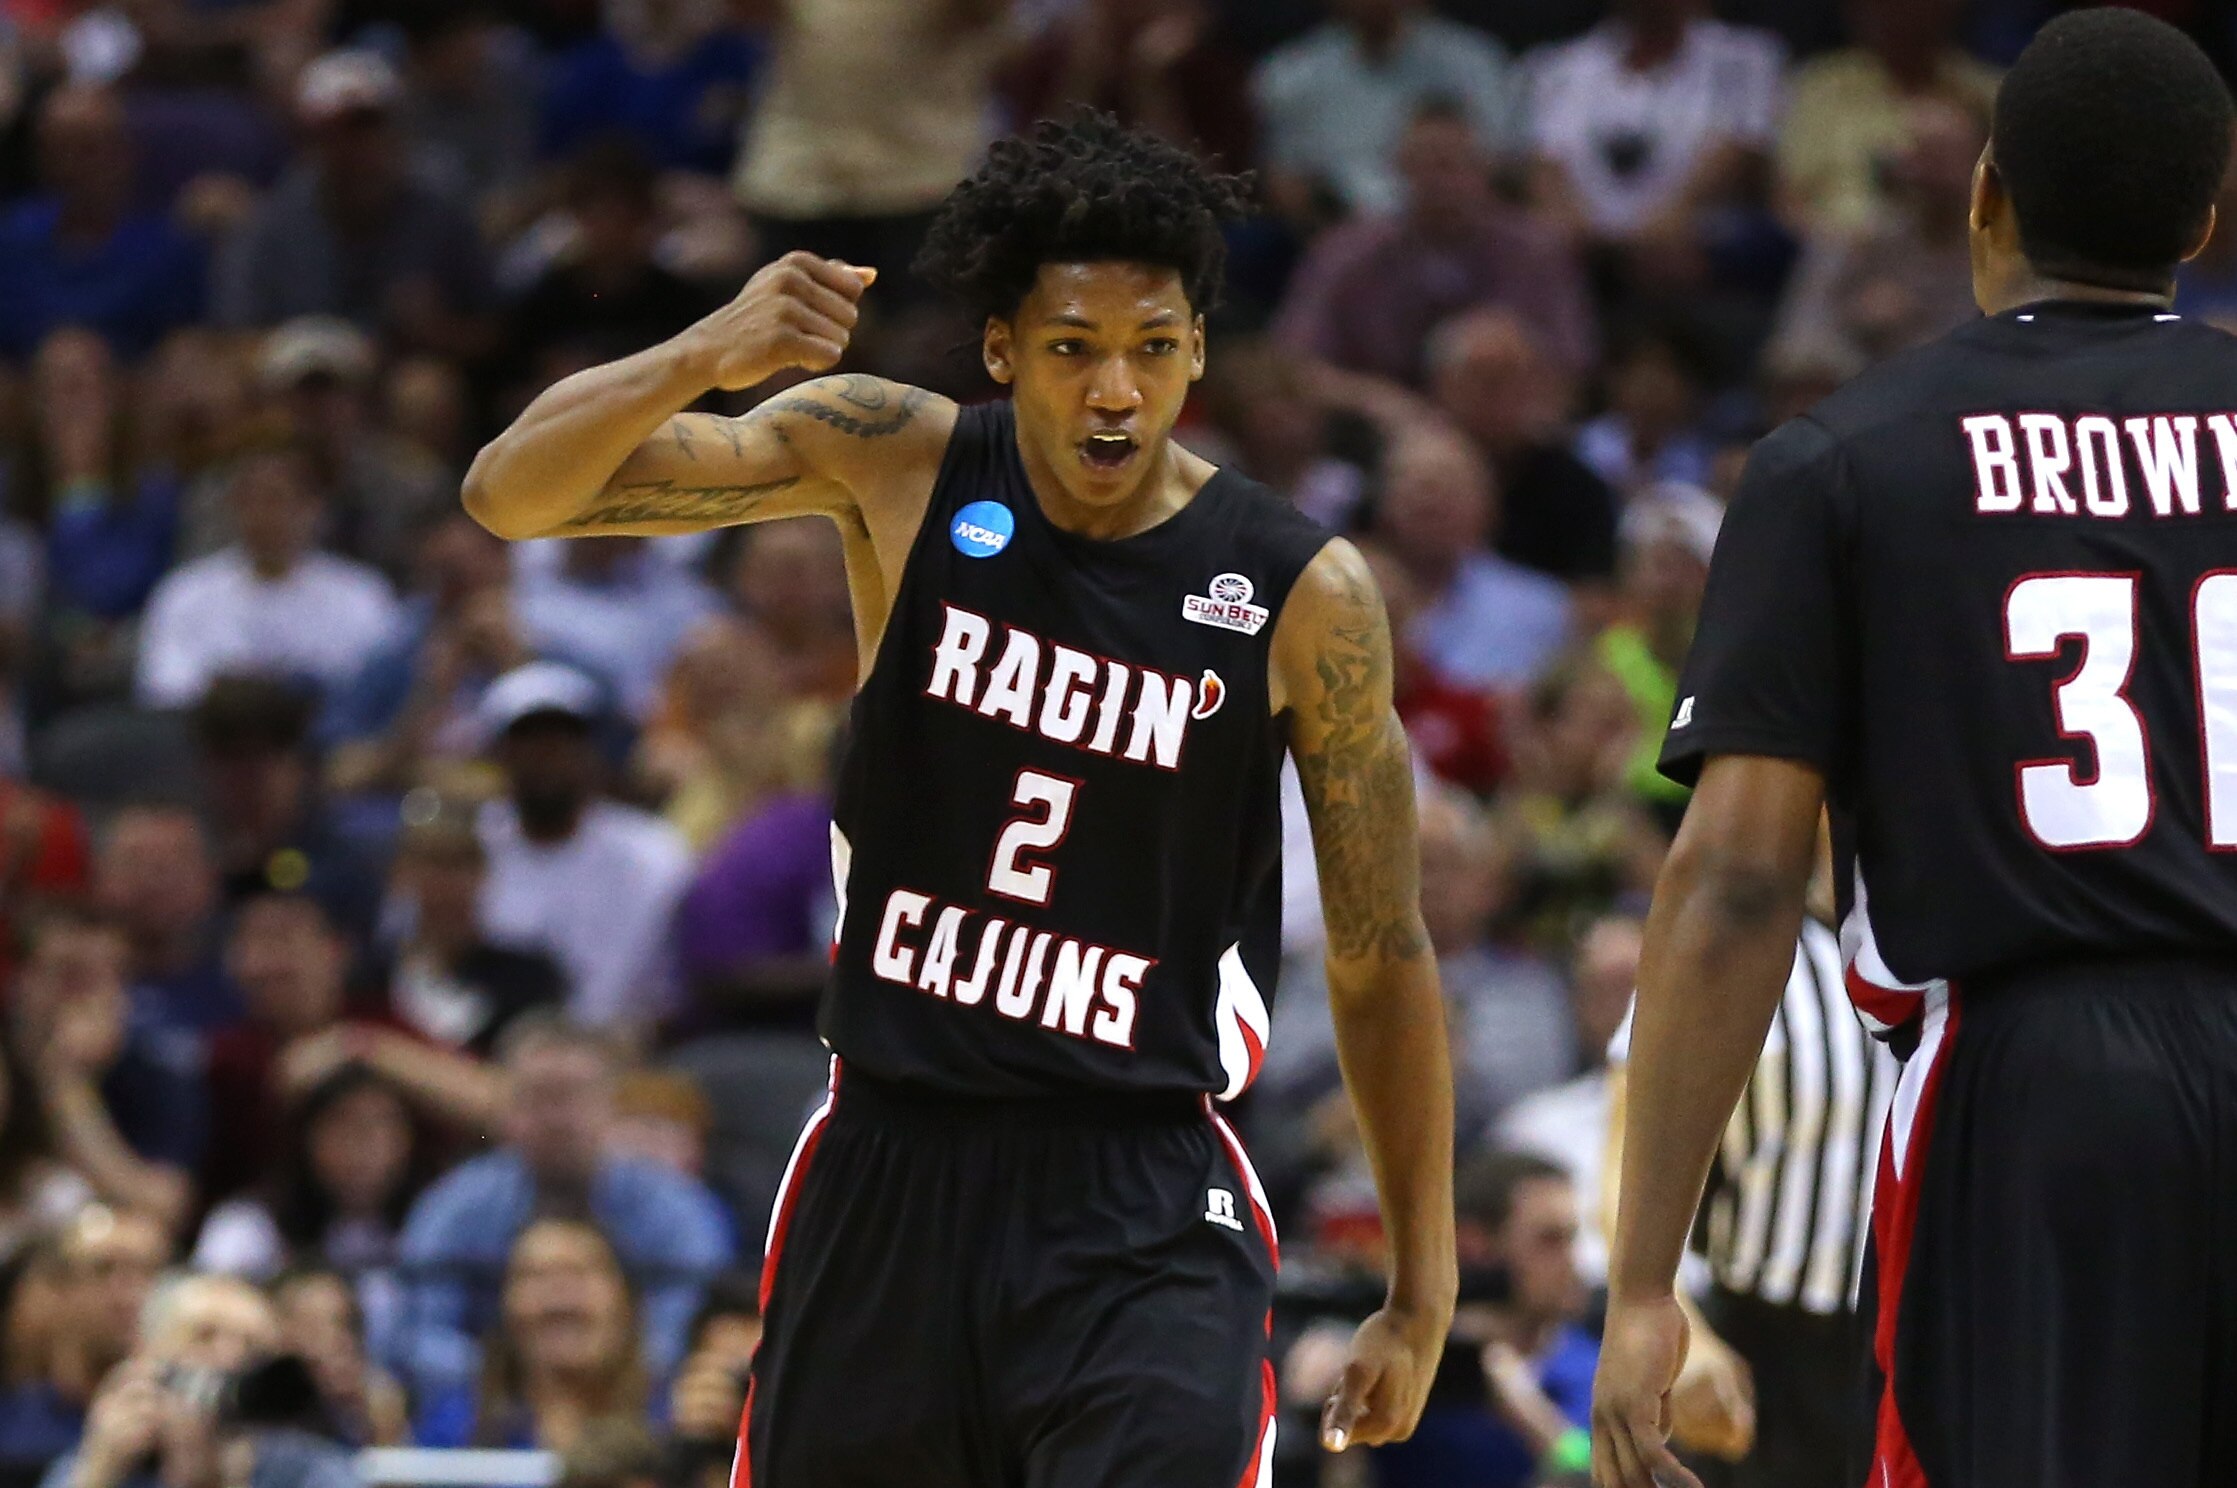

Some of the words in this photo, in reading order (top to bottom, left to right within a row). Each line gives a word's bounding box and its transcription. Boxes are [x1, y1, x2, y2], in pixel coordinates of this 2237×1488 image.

[954, 521, 1006, 549] NCAA
[1186, 598, 1224, 617] SUN
[1228, 604, 1269, 625] BELT
[986, 769, 1084, 906] 2
[872, 889, 1158, 1051] CAJUNS
